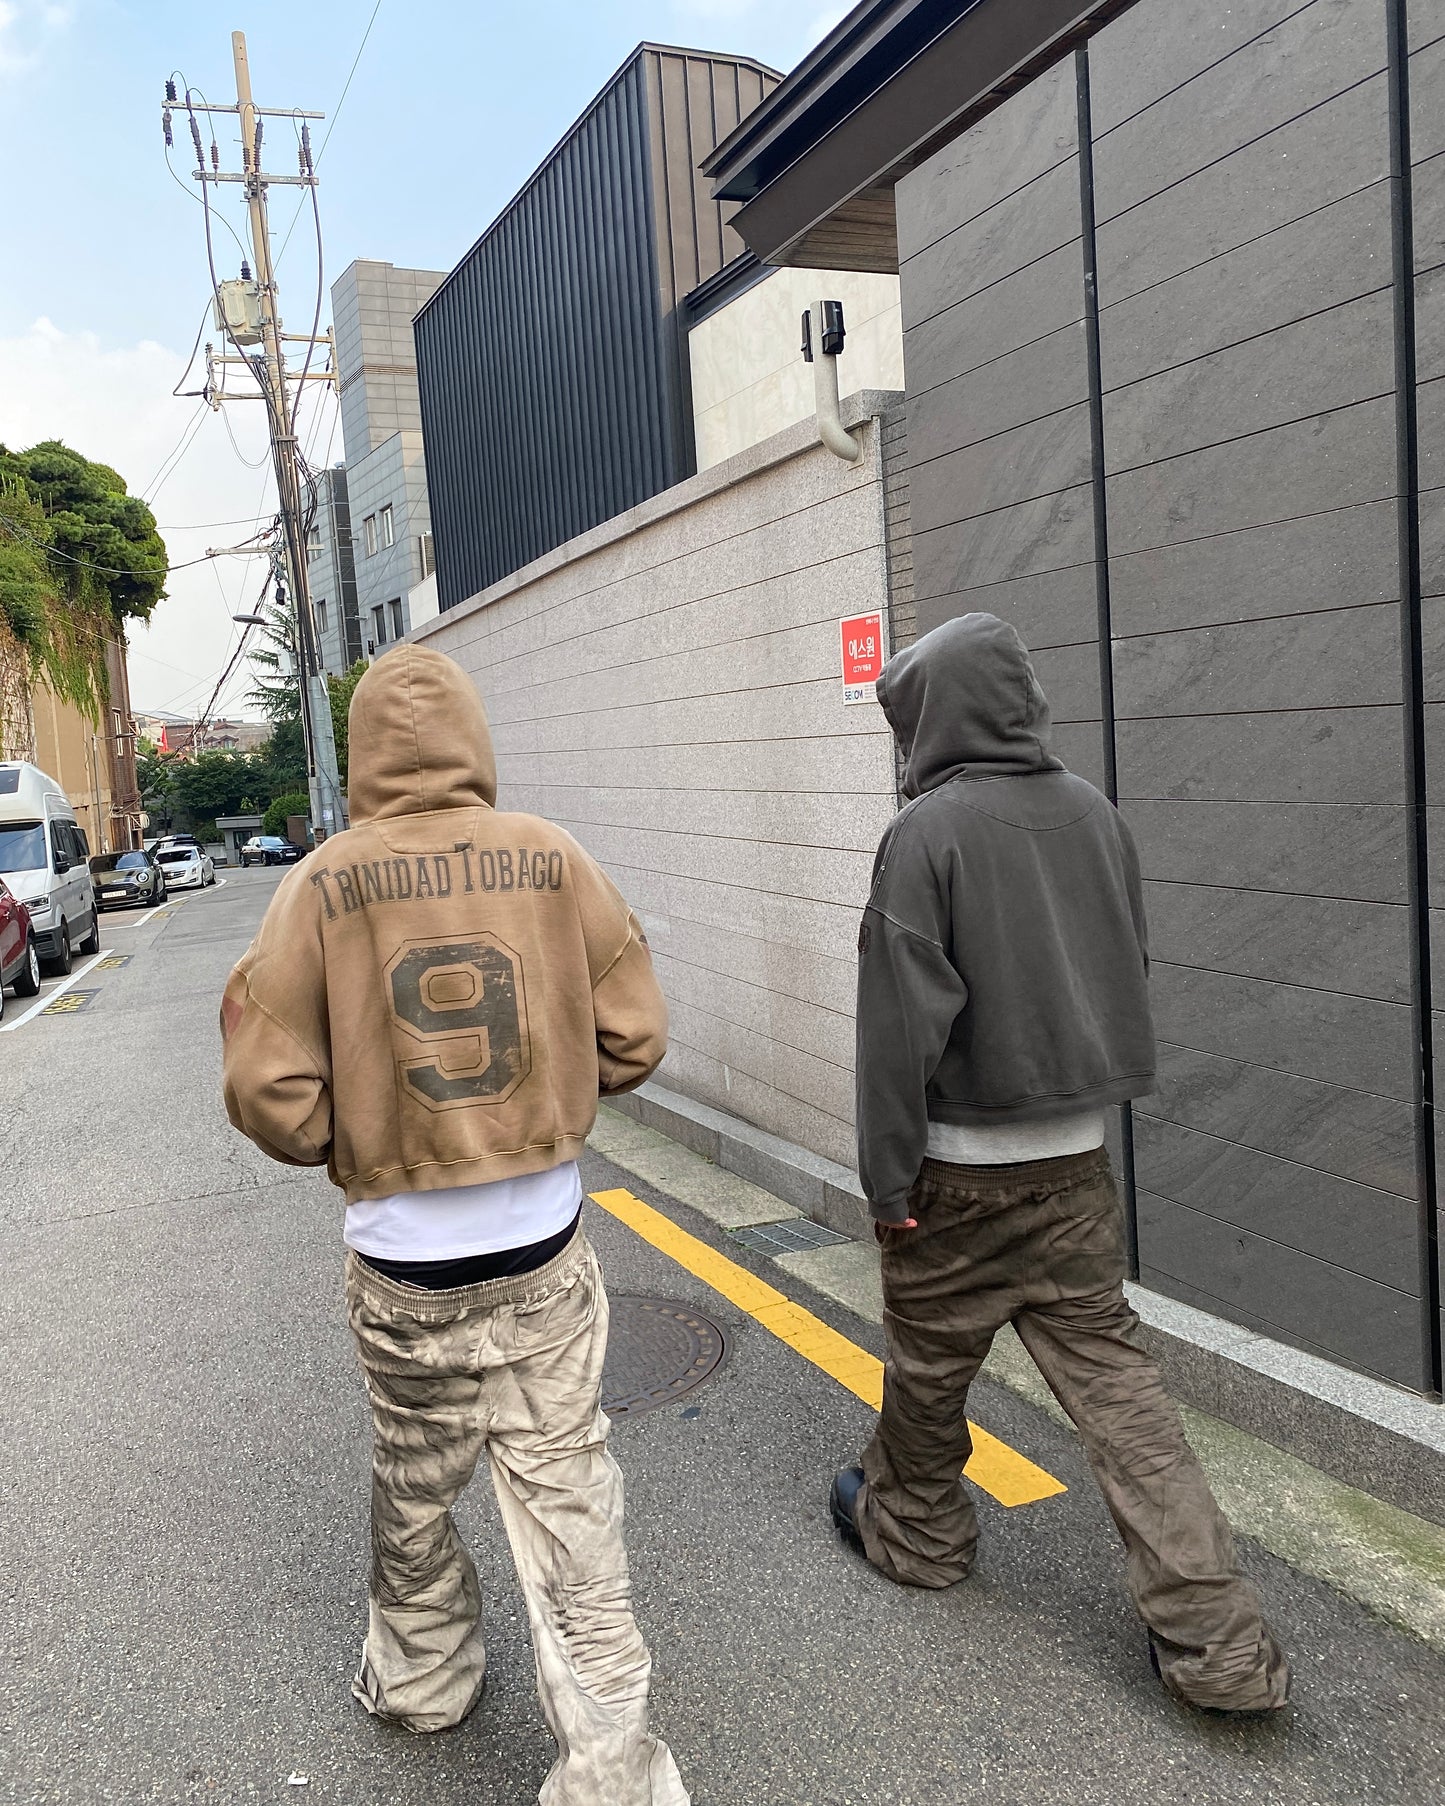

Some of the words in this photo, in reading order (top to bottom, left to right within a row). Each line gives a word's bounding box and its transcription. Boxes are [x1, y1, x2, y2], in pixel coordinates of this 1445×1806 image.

[848, 636, 875, 660] 에스원
[309, 855, 453, 923] TRINIDAD
[453, 840, 564, 895] TOBAGO
[382, 931, 532, 1113] 9
